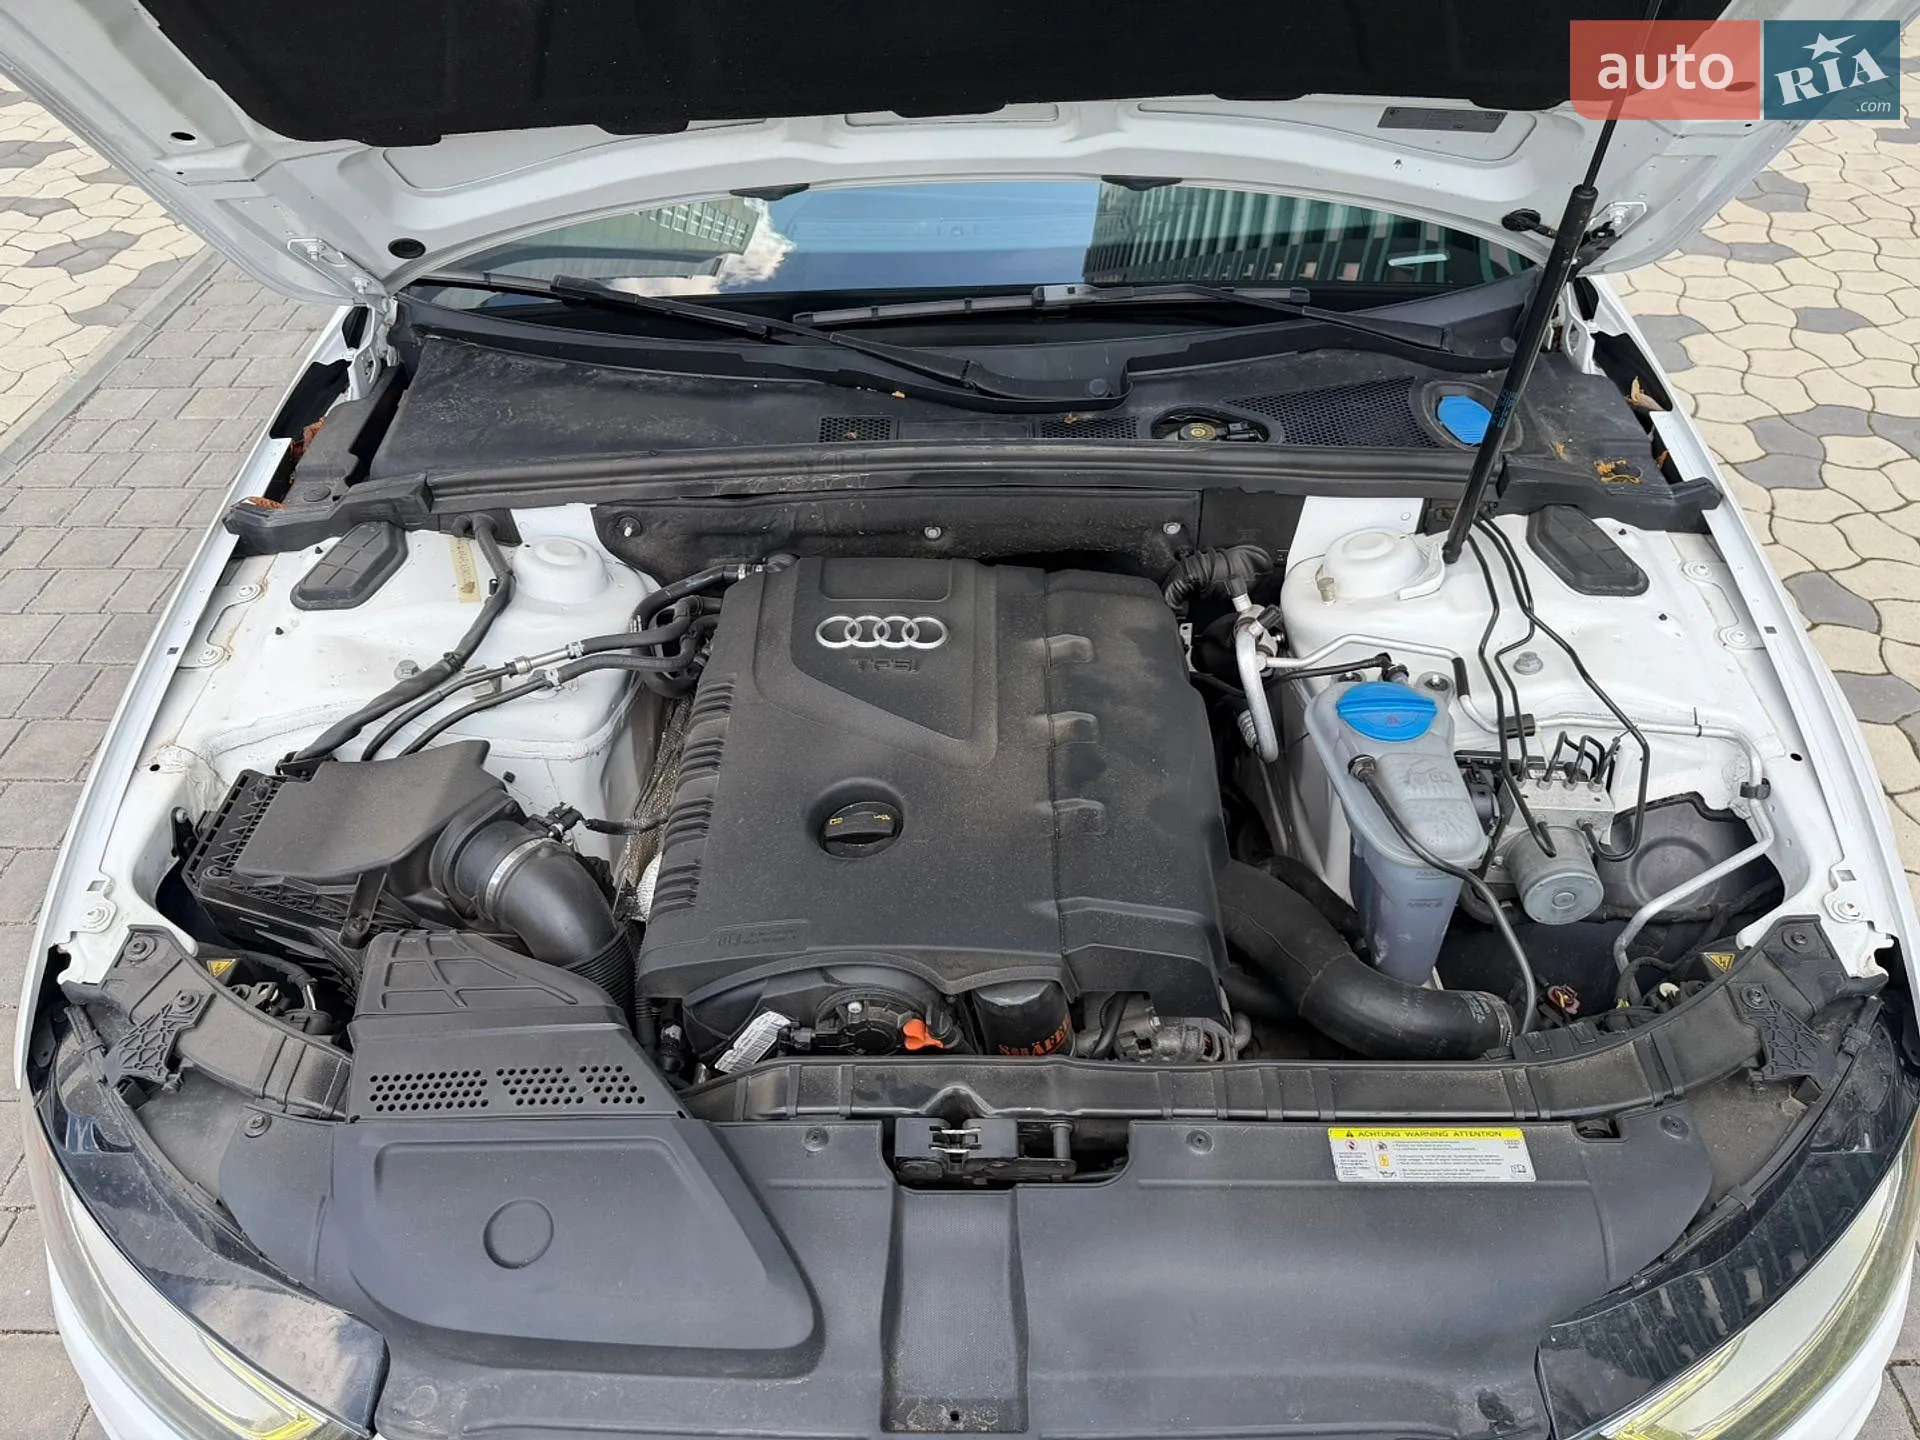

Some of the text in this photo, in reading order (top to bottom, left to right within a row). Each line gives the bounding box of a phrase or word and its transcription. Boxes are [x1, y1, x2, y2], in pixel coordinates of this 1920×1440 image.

[1358, 1130, 1502, 1138] ACHTUNG WARNING ATTENTION
